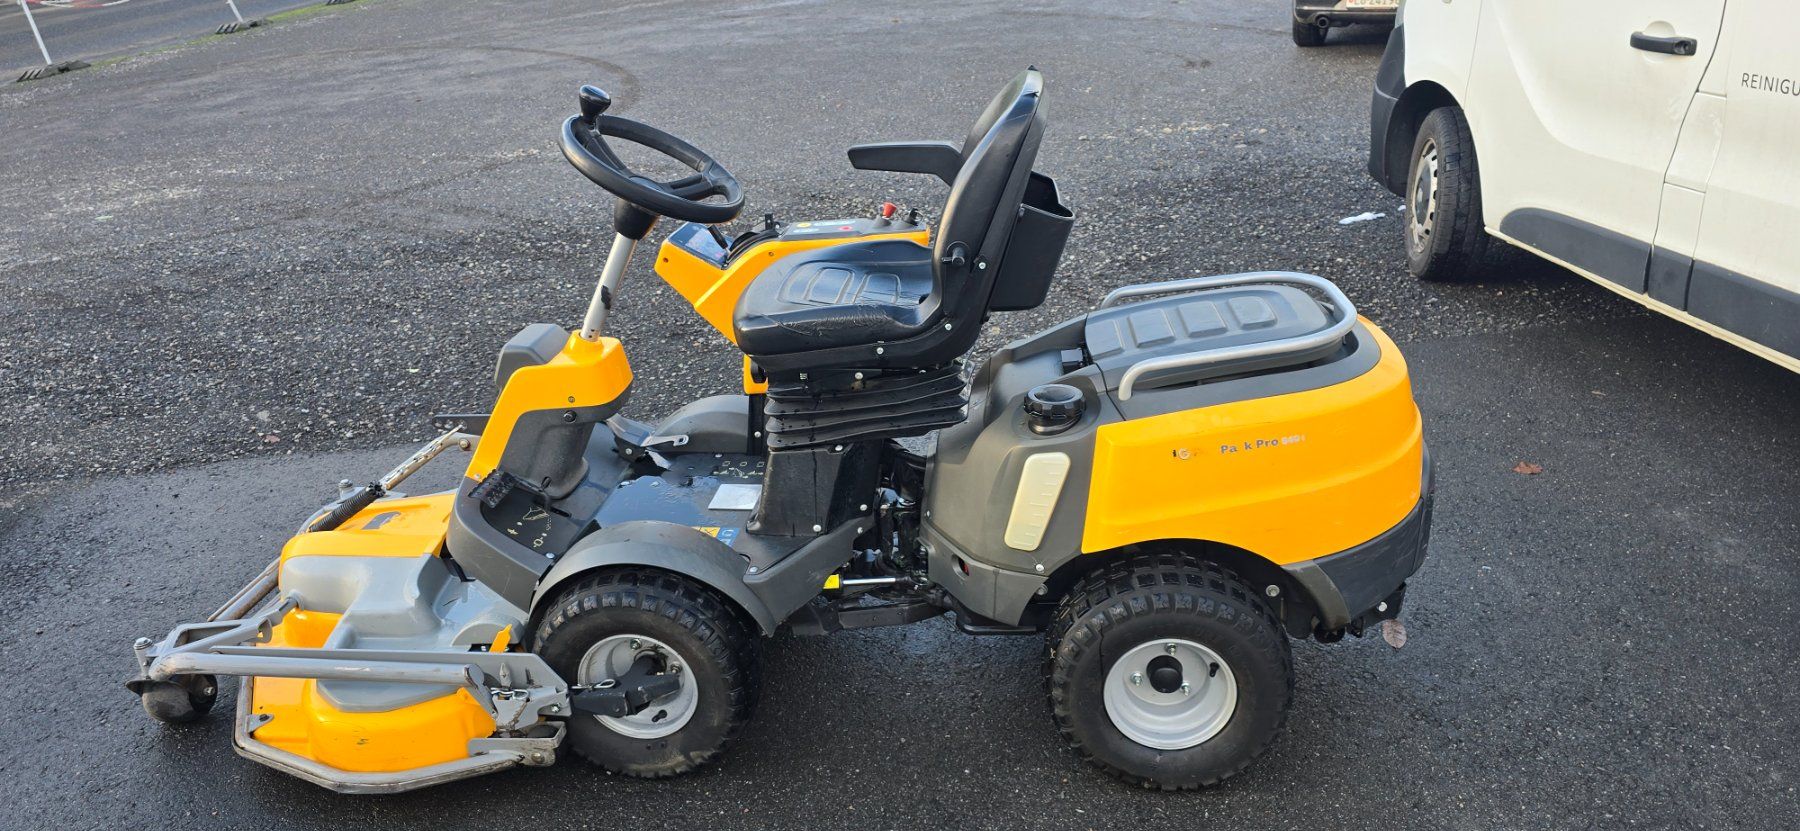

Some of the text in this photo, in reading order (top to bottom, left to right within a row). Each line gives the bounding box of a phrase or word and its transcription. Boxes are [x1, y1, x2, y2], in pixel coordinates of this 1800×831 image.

[1741, 72, 1800, 97] REINIGU
[1220, 441, 1253, 454] Pak
[1256, 438, 1279, 449] Pro
